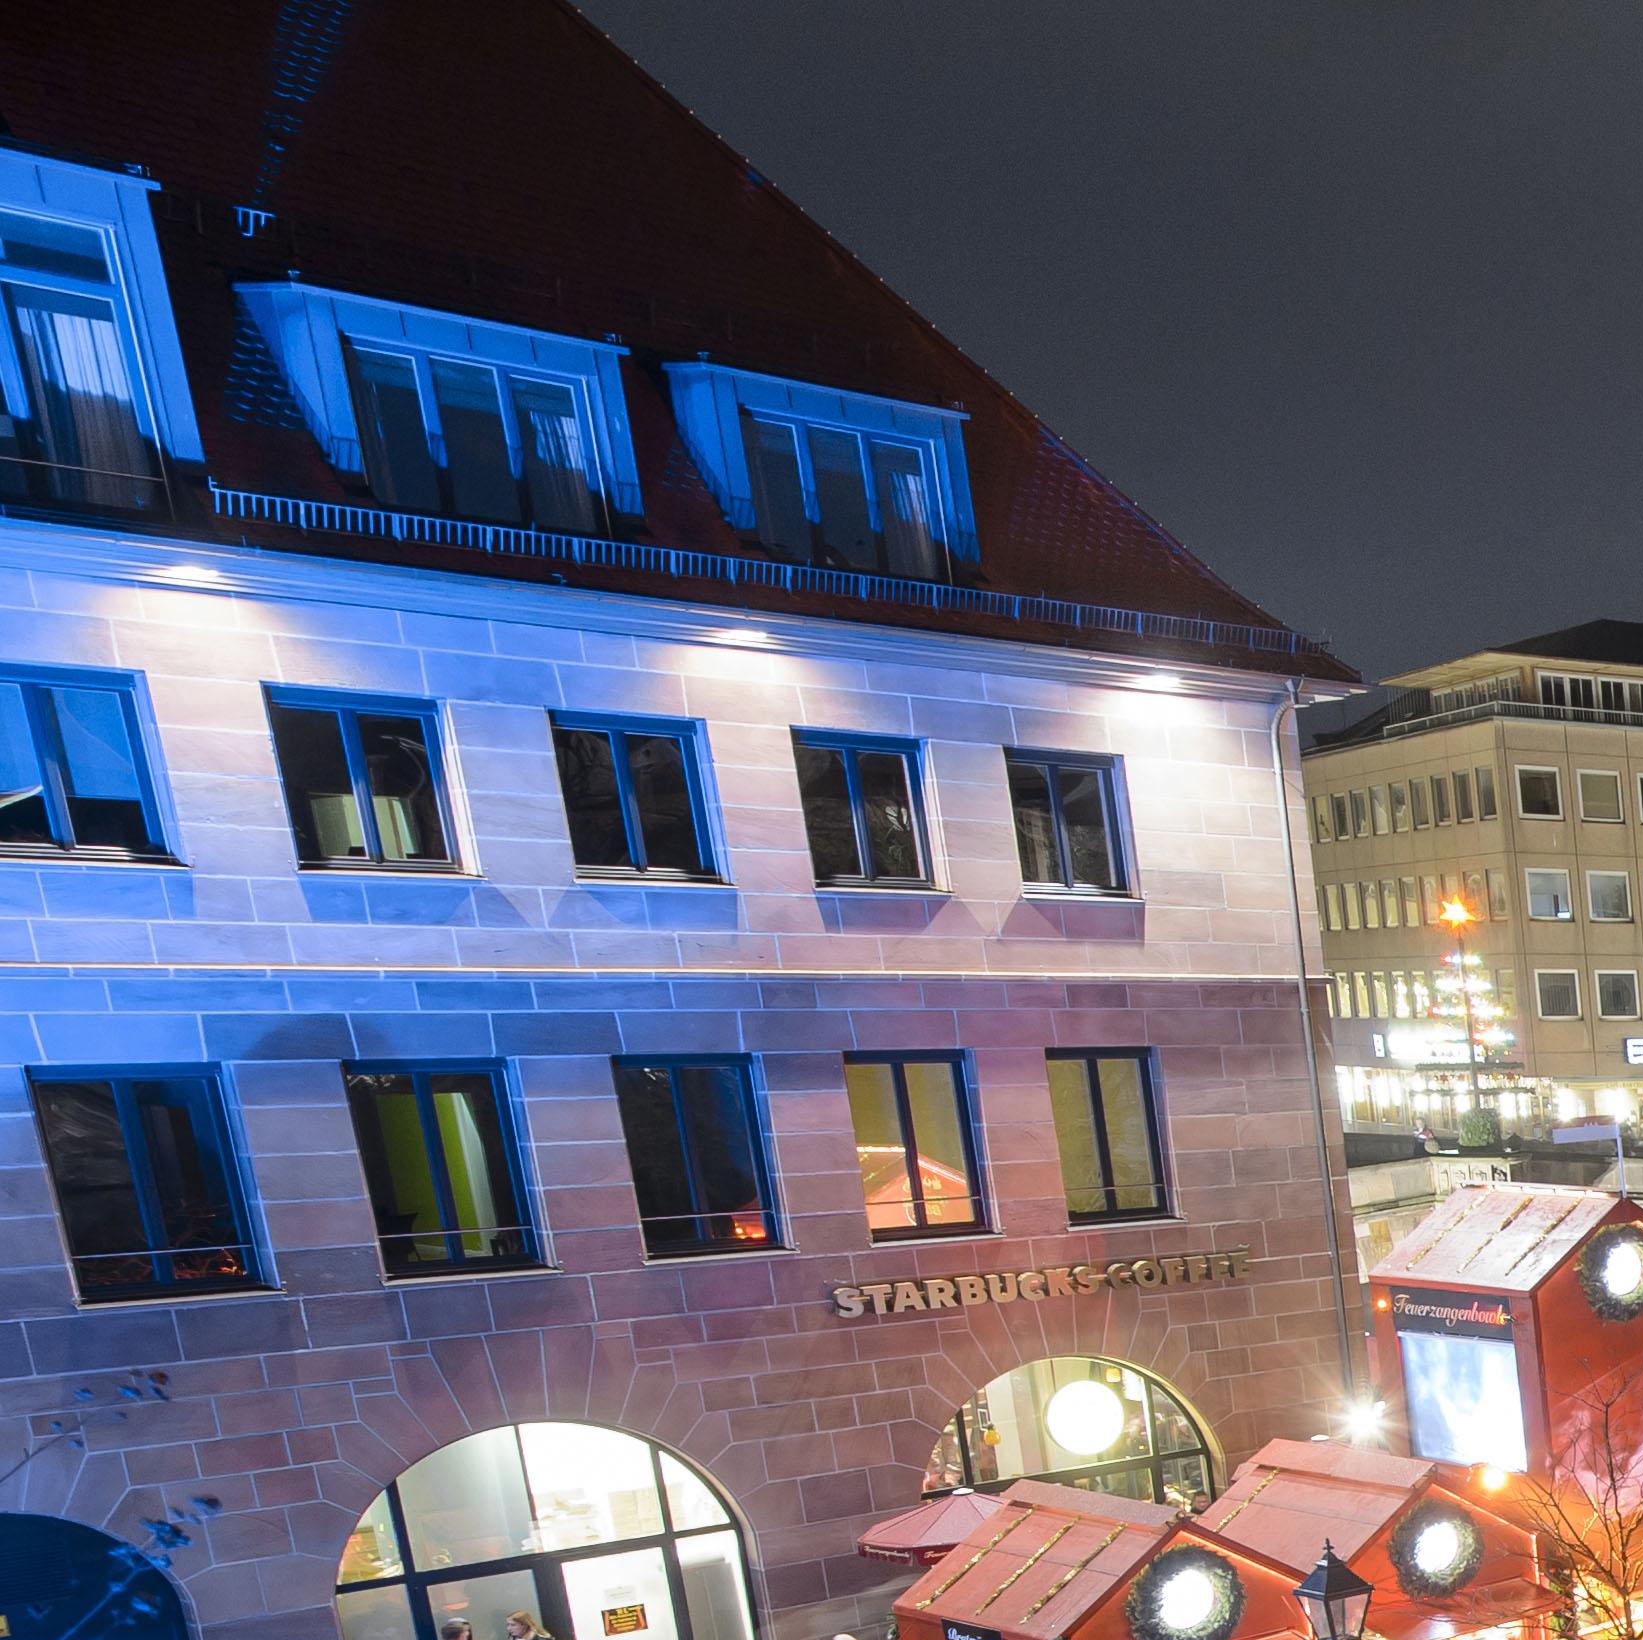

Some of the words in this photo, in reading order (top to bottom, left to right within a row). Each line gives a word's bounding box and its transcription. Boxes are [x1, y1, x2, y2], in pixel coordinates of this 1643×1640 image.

[832, 1263, 1101, 1319] STARBUCKS
[1106, 1250, 1254, 1289] COFFEE
[1393, 1294, 1507, 1327] Feuerzangenbowle
